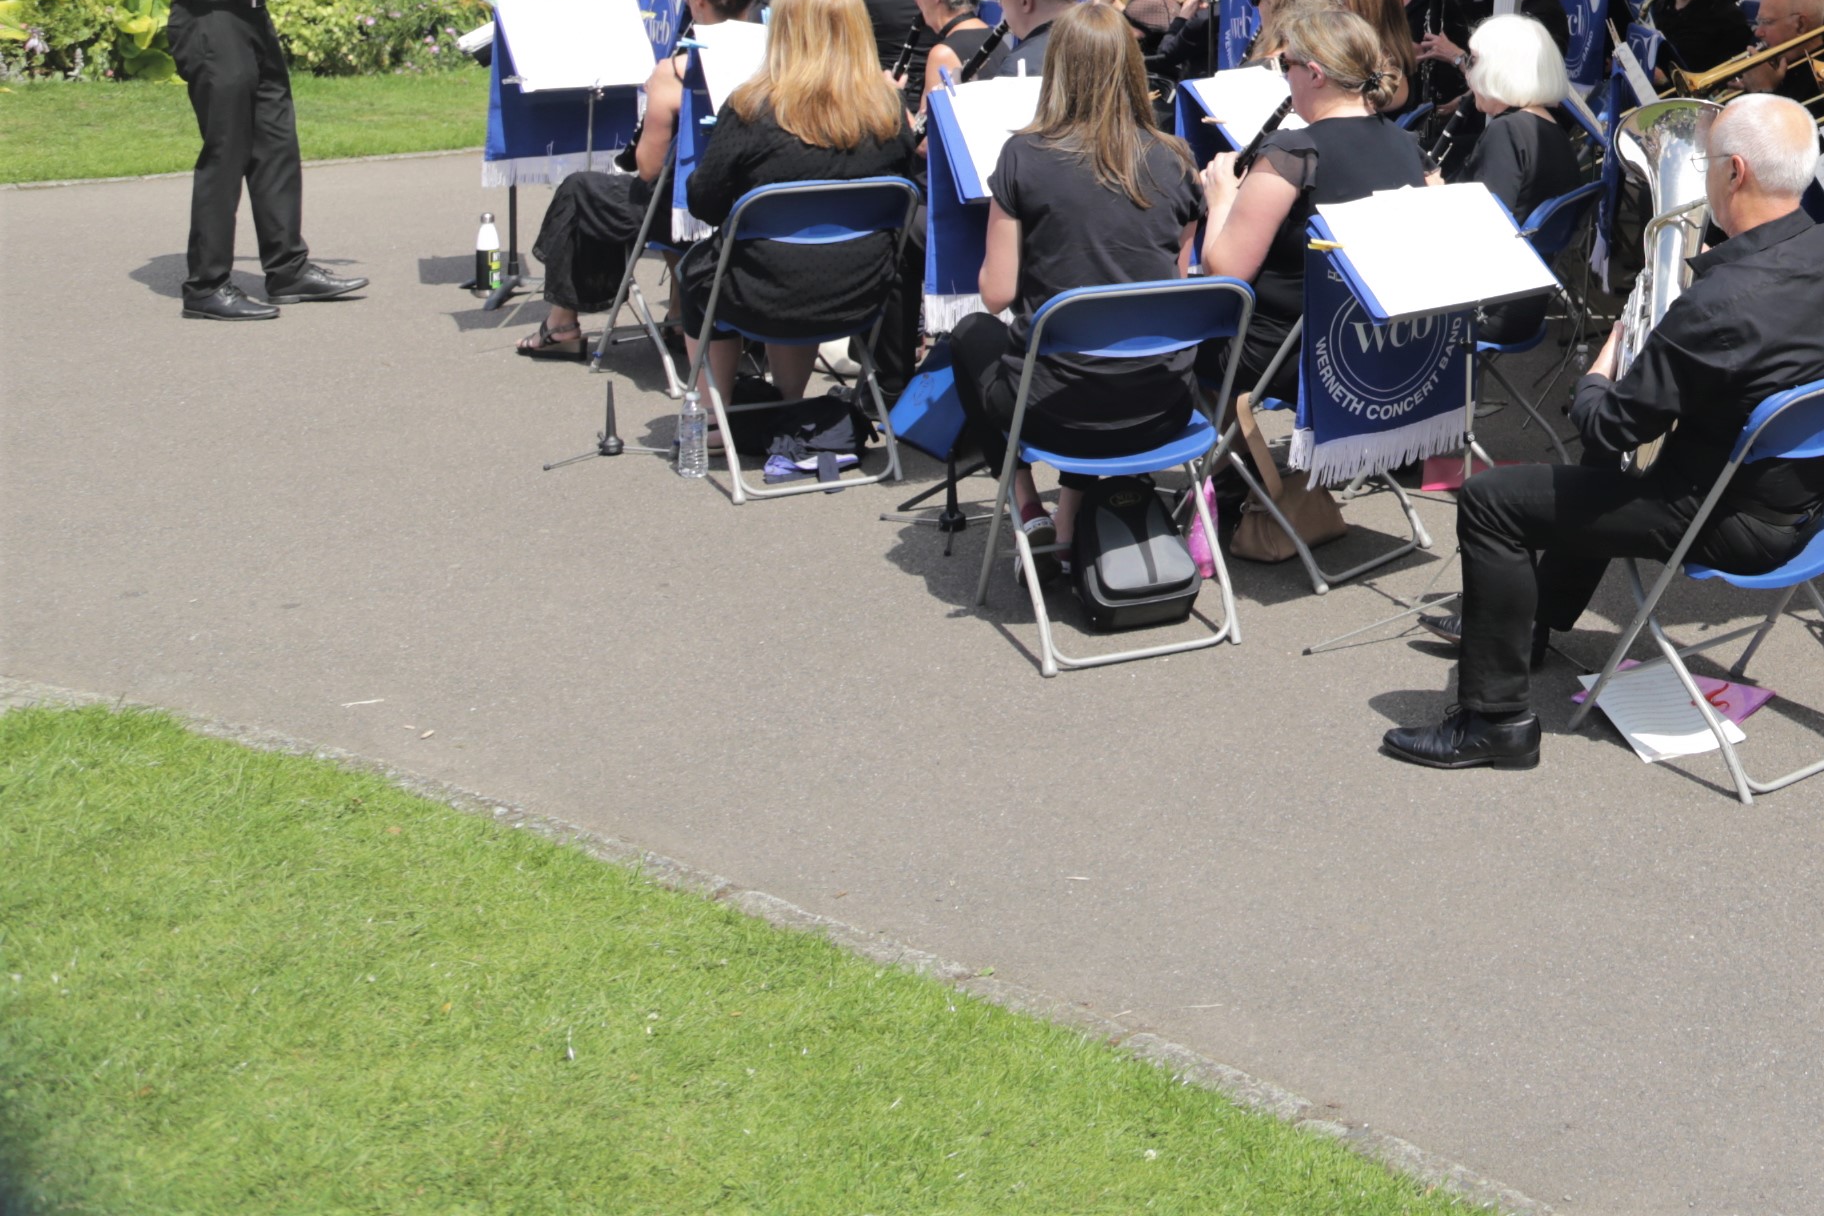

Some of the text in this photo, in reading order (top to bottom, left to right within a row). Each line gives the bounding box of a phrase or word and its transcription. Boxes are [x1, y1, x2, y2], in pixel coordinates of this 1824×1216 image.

[1315, 317, 1462, 421] WERNETH CONCERT BAND
